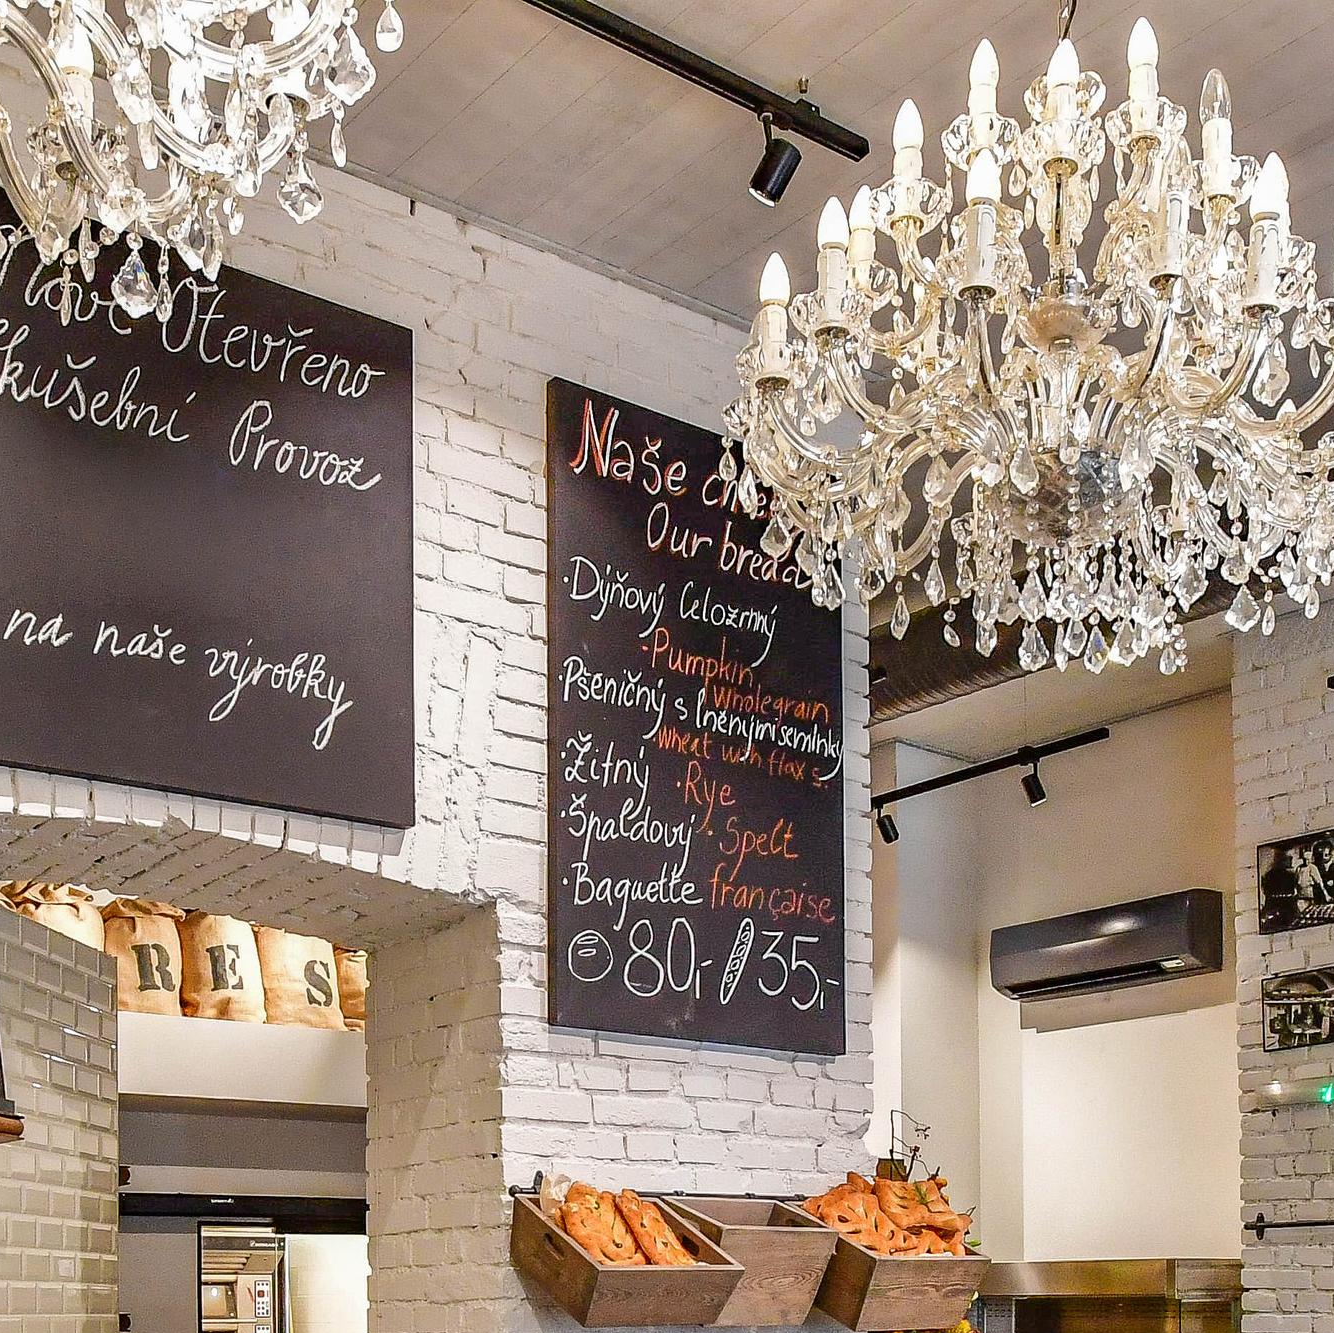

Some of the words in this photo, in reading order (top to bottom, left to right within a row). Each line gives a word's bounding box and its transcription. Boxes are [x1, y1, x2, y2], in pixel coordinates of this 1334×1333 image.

[165, 274, 385, 400] Otevřeno
[228, 400, 381, 491] Provoz
[569, 398, 687, 496] Naše
[647, 502, 711, 559] Our
[568, 555, 665, 639] Dýňový
[3, 606, 73, 647] na
[93, 620, 187, 664] naše
[204, 637, 353, 750] výrobky
[563, 656, 667, 740] Pšeničný
[674, 697, 688, 721] s
[650, 628, 755, 695] Pumpkin
[565, 730, 650, 820] Žitný
[658, 725, 712, 760] Wheat
[683, 761, 735, 830] Rye
[567, 793, 696, 885] Špaldový
[719, 817, 799, 881] Spelt
[572, 862, 704, 930] Baguette
[708, 862, 836, 923] française
[623, 918, 713, 999] 80,-
[757, 930, 840, 1011] 35,-
